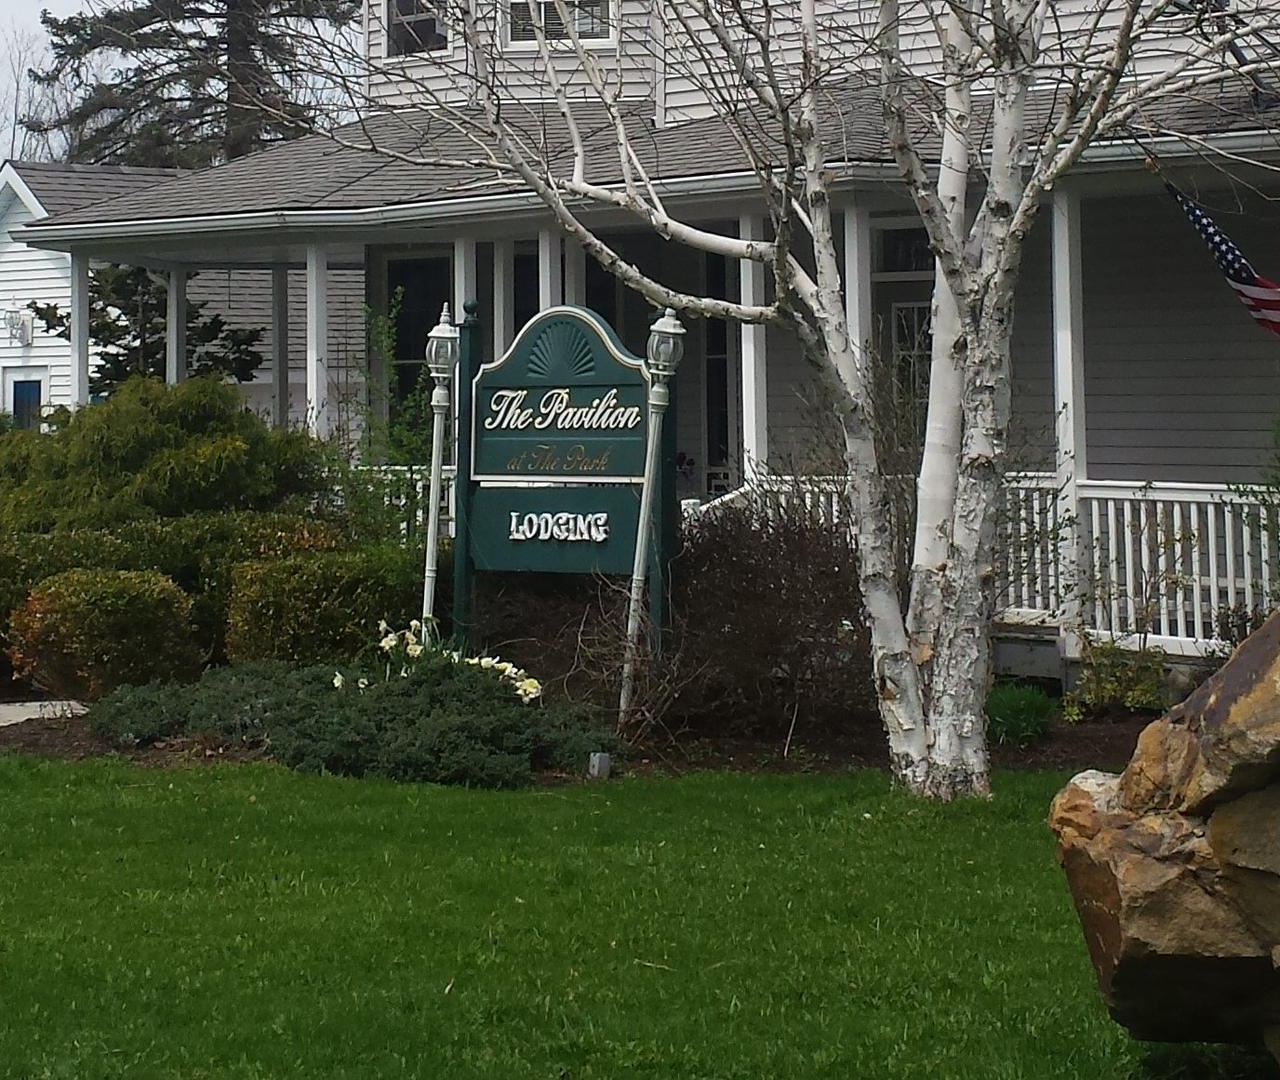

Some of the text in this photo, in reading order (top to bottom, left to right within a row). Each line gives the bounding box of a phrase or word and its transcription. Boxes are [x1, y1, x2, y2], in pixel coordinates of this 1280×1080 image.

[485, 388, 641, 429] The Pavilion
[507, 444, 613, 470] at The Park
[509, 512, 609, 542] LODGING
